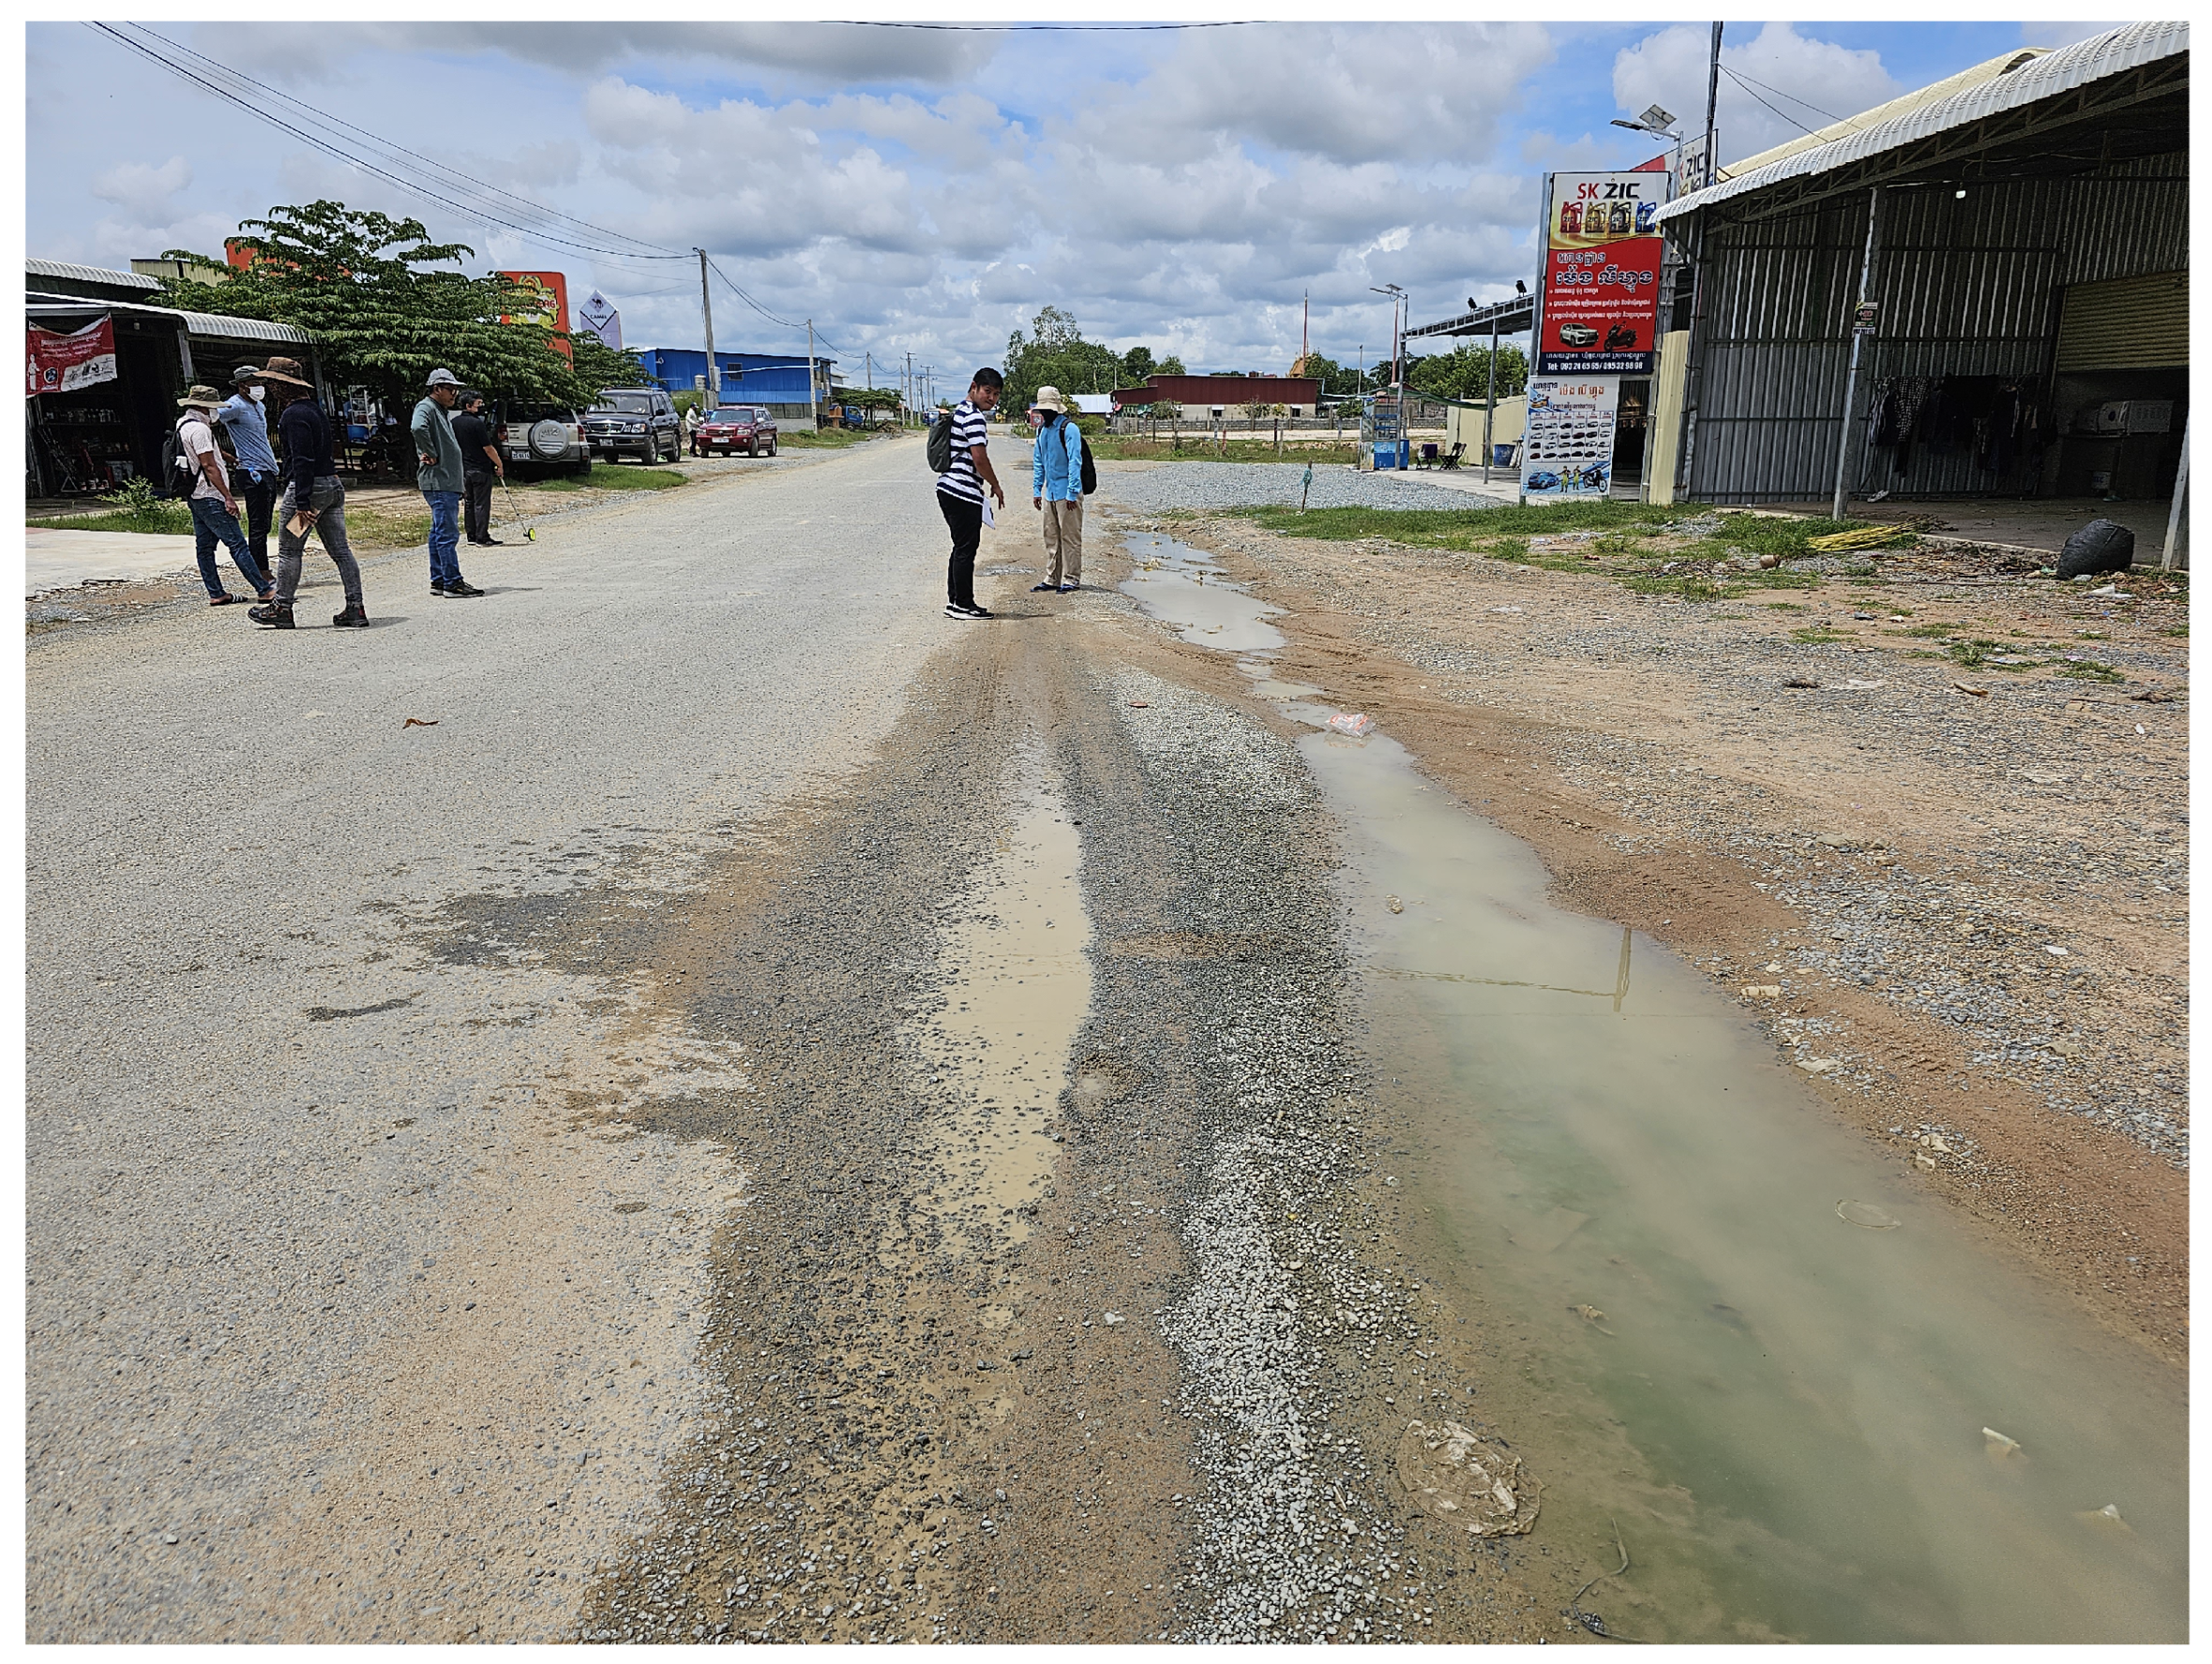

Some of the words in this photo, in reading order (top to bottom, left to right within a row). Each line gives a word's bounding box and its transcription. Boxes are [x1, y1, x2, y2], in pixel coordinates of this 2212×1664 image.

[1686, 152, 1704, 179] ZIC
[1577, 183, 1600, 200] SK
[1603, 183, 1641, 200] ZIC
